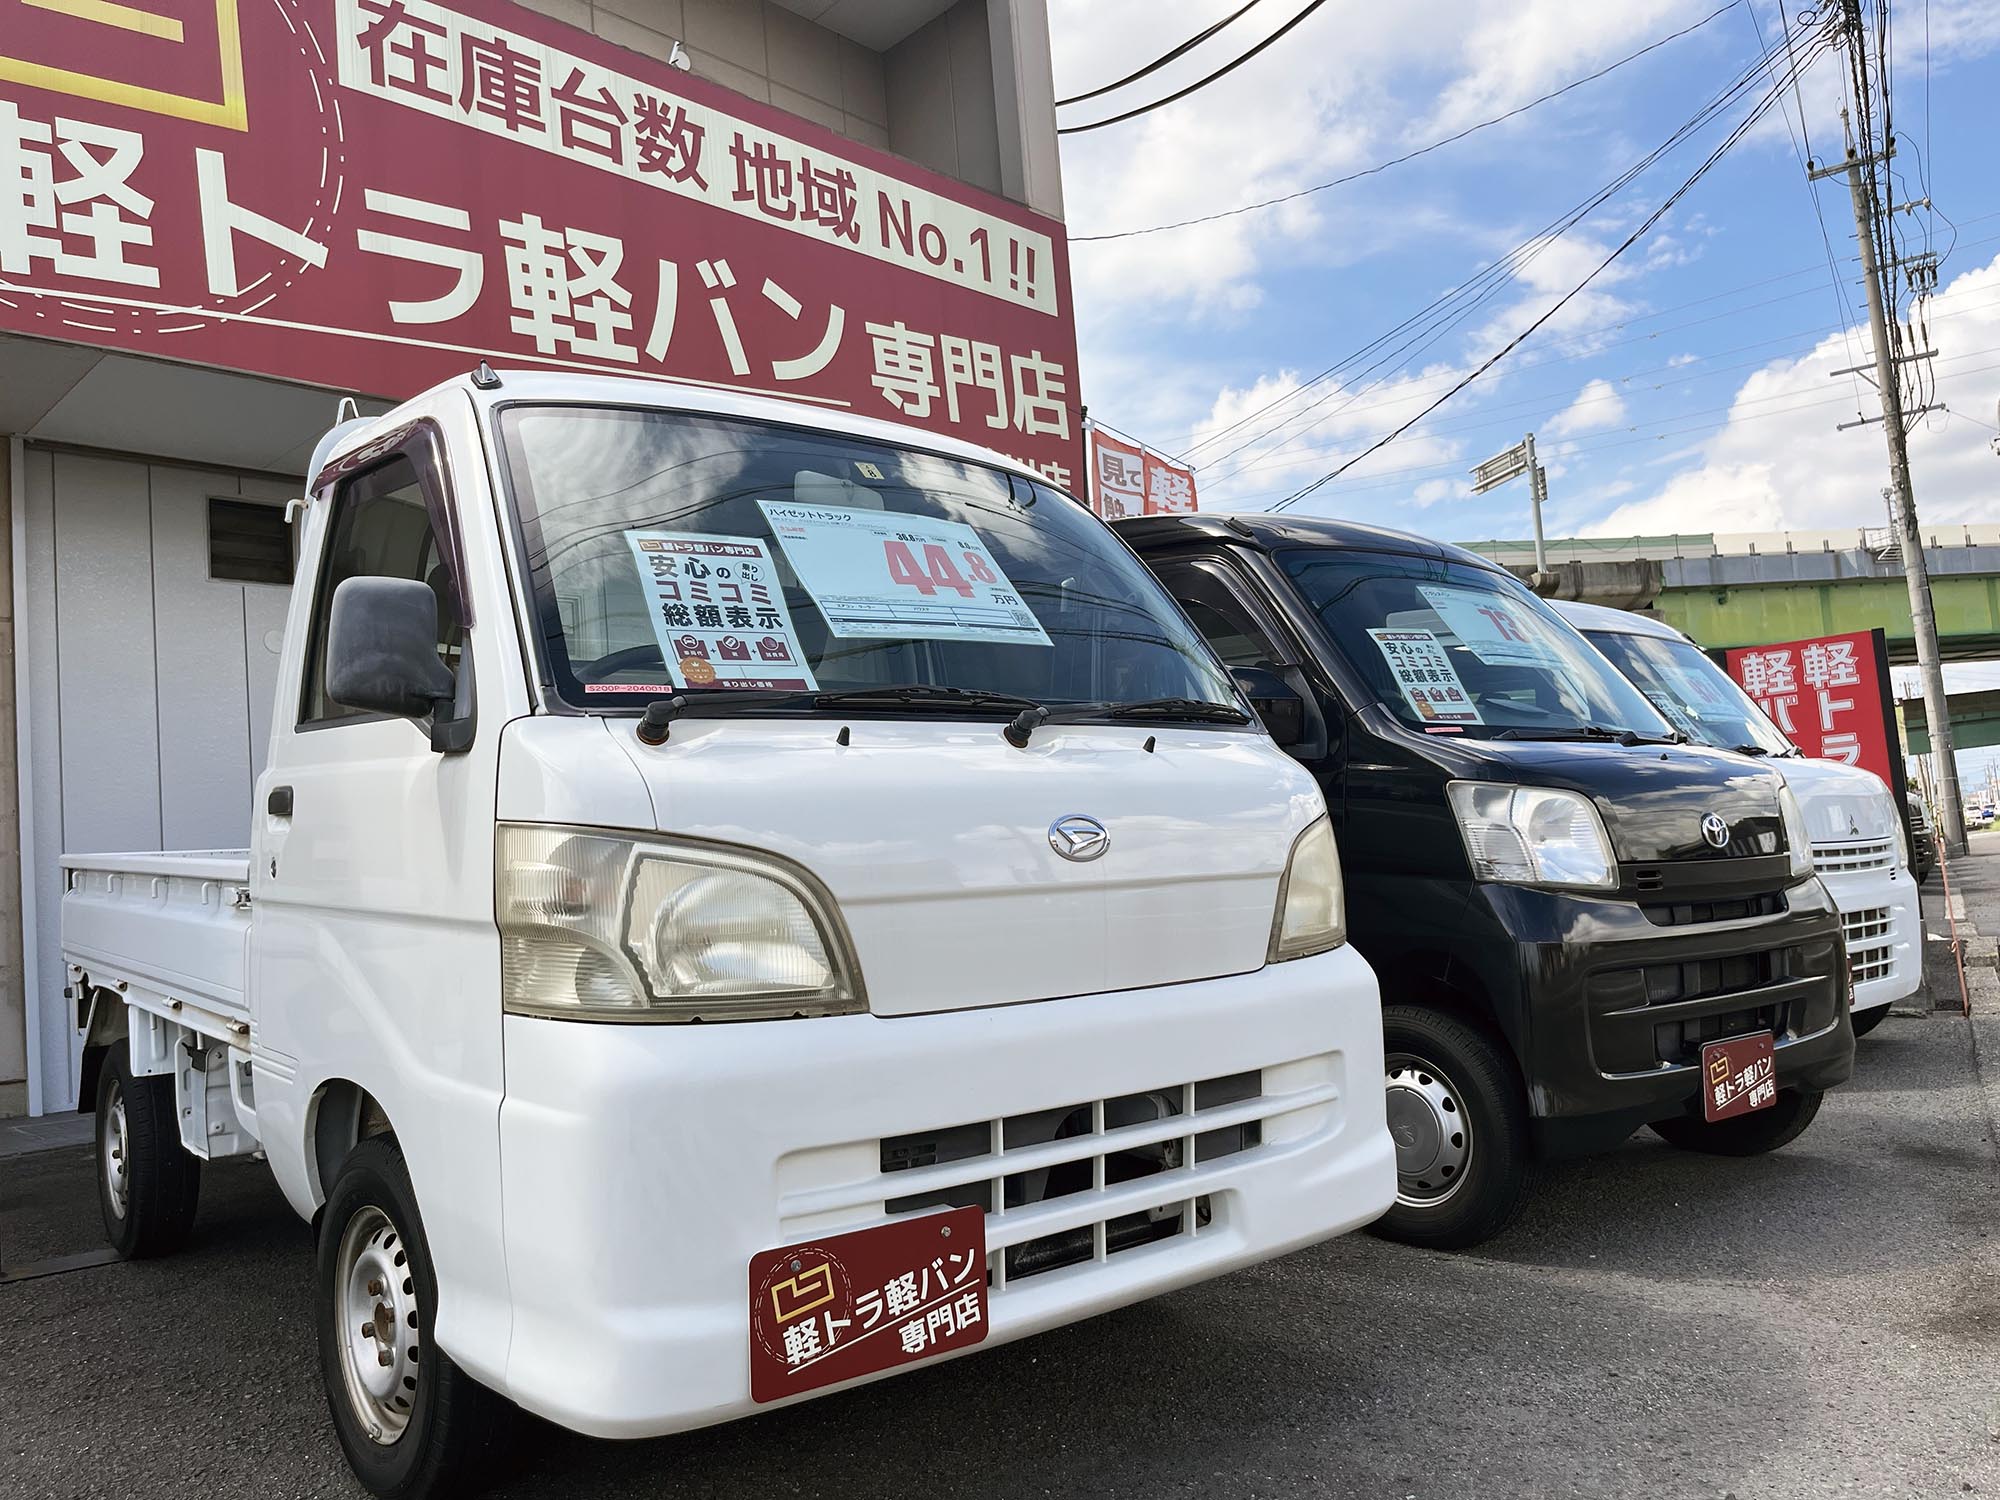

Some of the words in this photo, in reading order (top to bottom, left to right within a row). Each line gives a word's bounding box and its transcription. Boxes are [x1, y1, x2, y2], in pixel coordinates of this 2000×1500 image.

[357, 0, 708, 192] 在庫台数
[729, 131, 861, 245] 地域
[1102, 453, 1142, 487] 見て
[769, 508, 852, 522] ハイゼットトラック
[648, 554, 731, 579] 安心の
[883, 540, 998, 599] 44.8
[990, 594, 1019, 605] 万円
[656, 580, 772, 605] コミコミ
[662, 603, 784, 630] 総額表示
[1384, 642, 1423, 655] 安心の
[1392, 656, 1446, 668] コミコミ
[1399, 669, 1454, 683] 総額表示
[1800, 641, 1860, 767] 軽トラ
[1714, 1056, 1772, 1106] 軽トラ軽バン
[1748, 1079, 1775, 1108] 専門店
[783, 1249, 975, 1364] 軽トラ軽バン
[898, 1292, 981, 1353] 専門店
